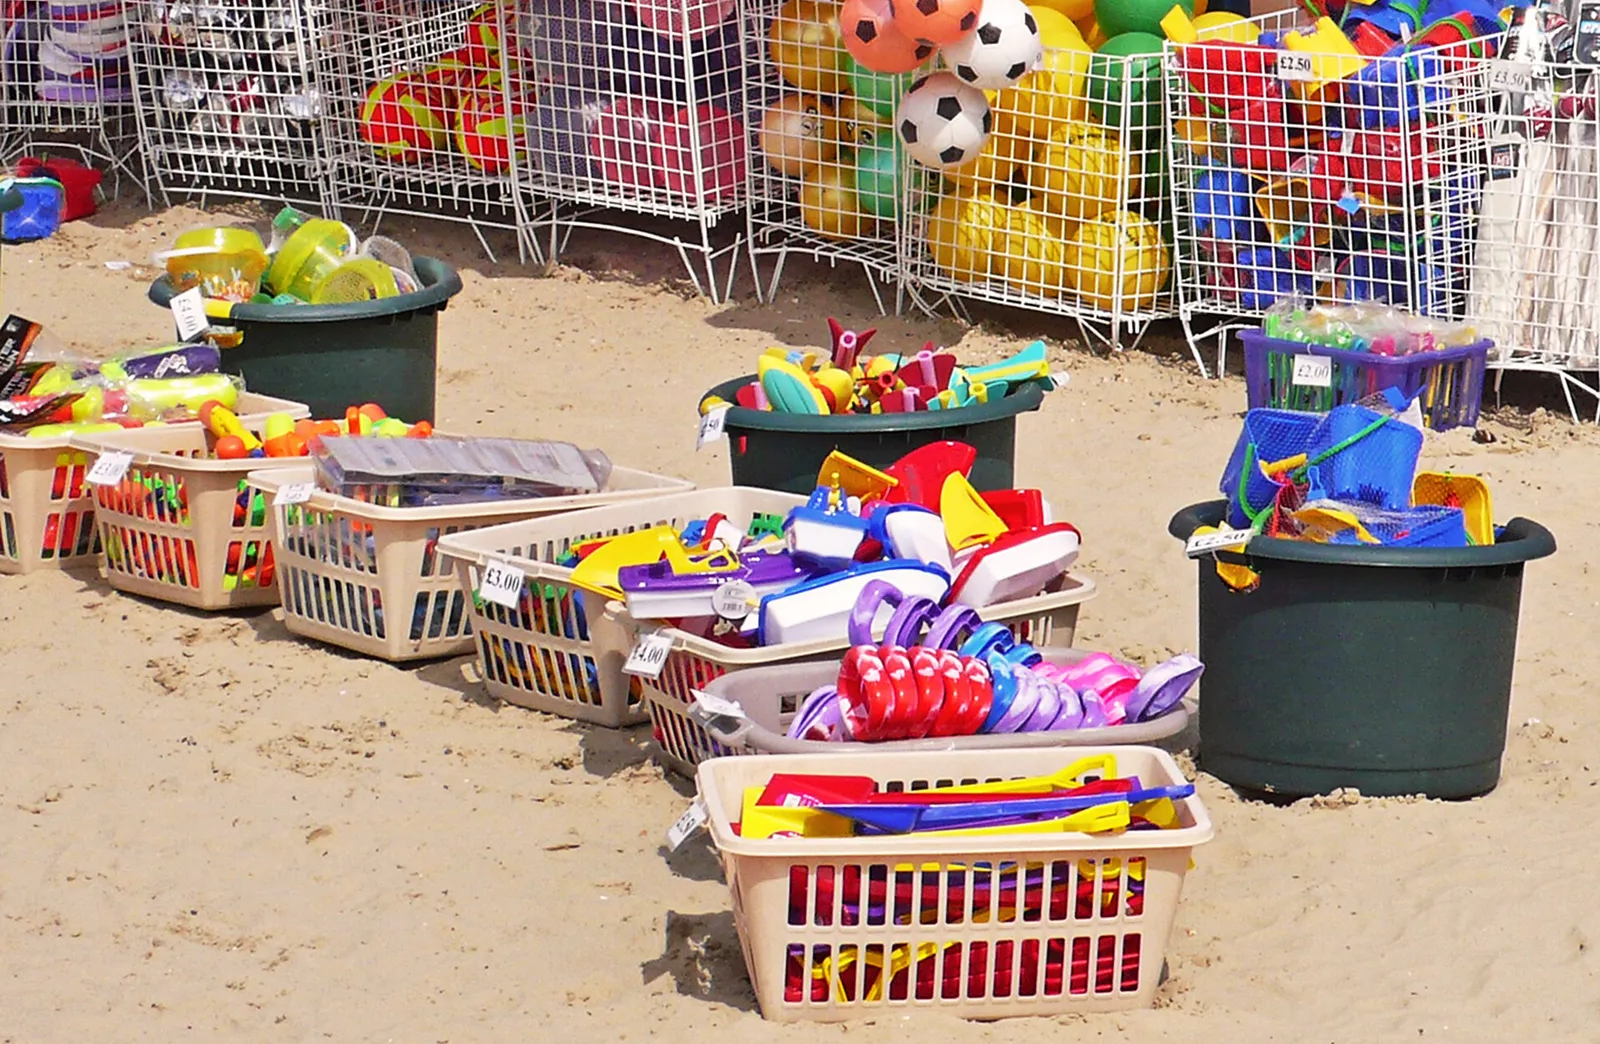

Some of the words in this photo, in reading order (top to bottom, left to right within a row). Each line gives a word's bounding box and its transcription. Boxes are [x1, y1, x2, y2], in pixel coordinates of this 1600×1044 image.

[1280, 56, 1311, 71] £2.50
[1494, 71, 1525, 86] £3.50
[1297, 364, 1329, 378] £2.00
[486, 567, 520, 593] £3.00
[631, 646, 664, 665] £4.00
